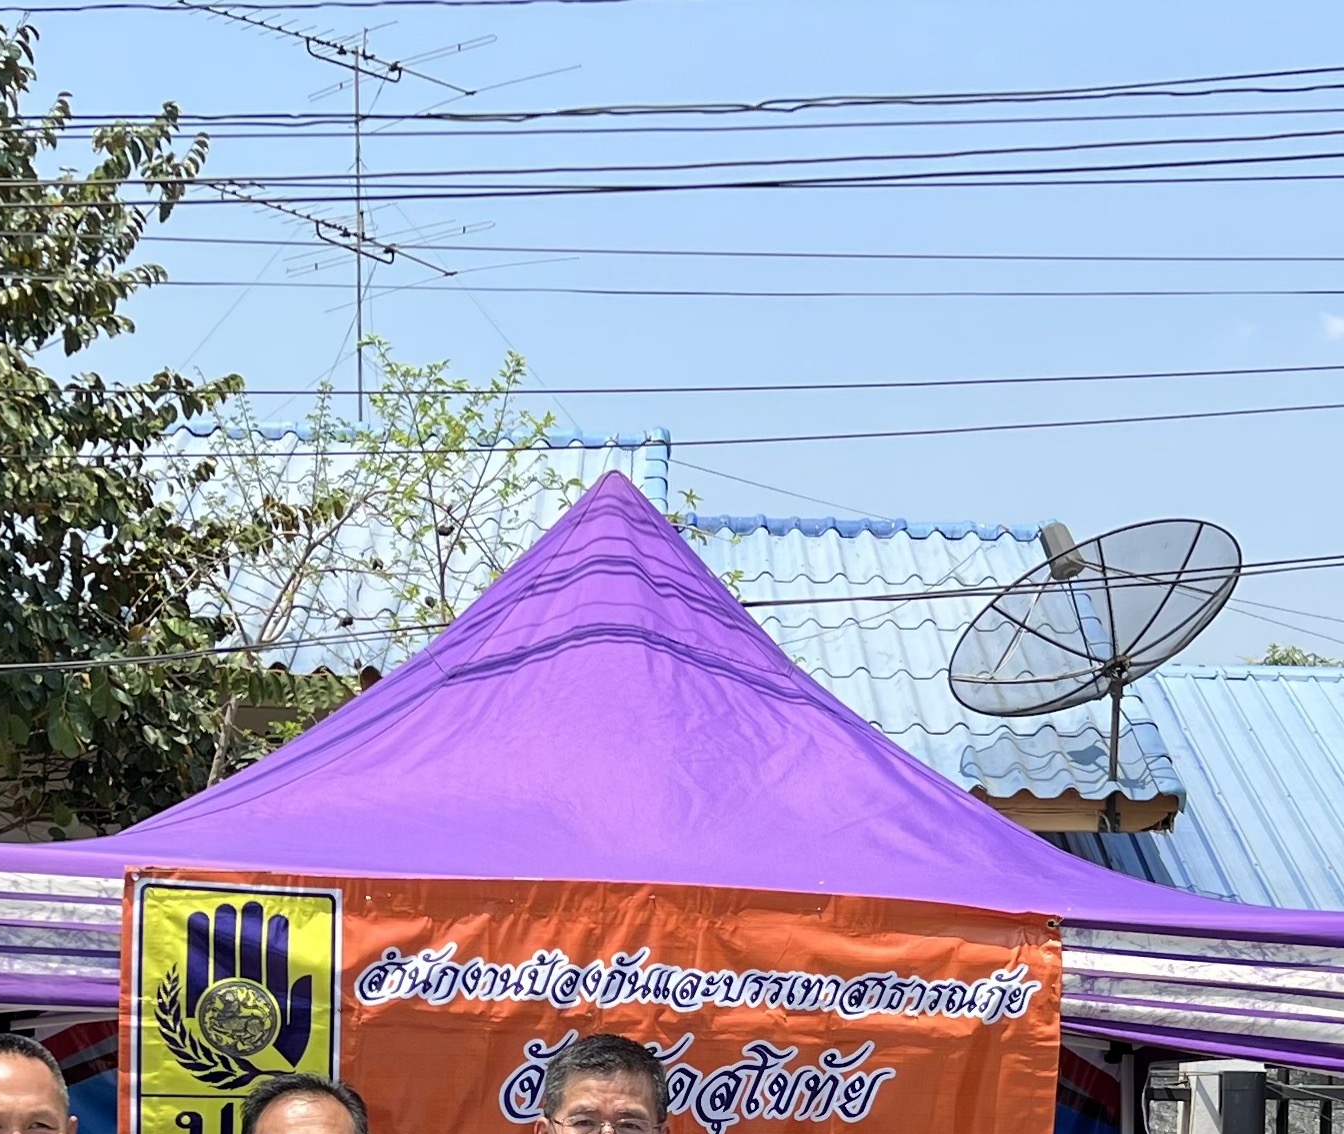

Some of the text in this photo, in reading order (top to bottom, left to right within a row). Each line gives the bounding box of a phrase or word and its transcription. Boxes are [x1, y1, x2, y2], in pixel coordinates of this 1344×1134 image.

[356, 944, 1039, 1023] สำนักงานป้องกันและบรรเทาสาธารณภัย
